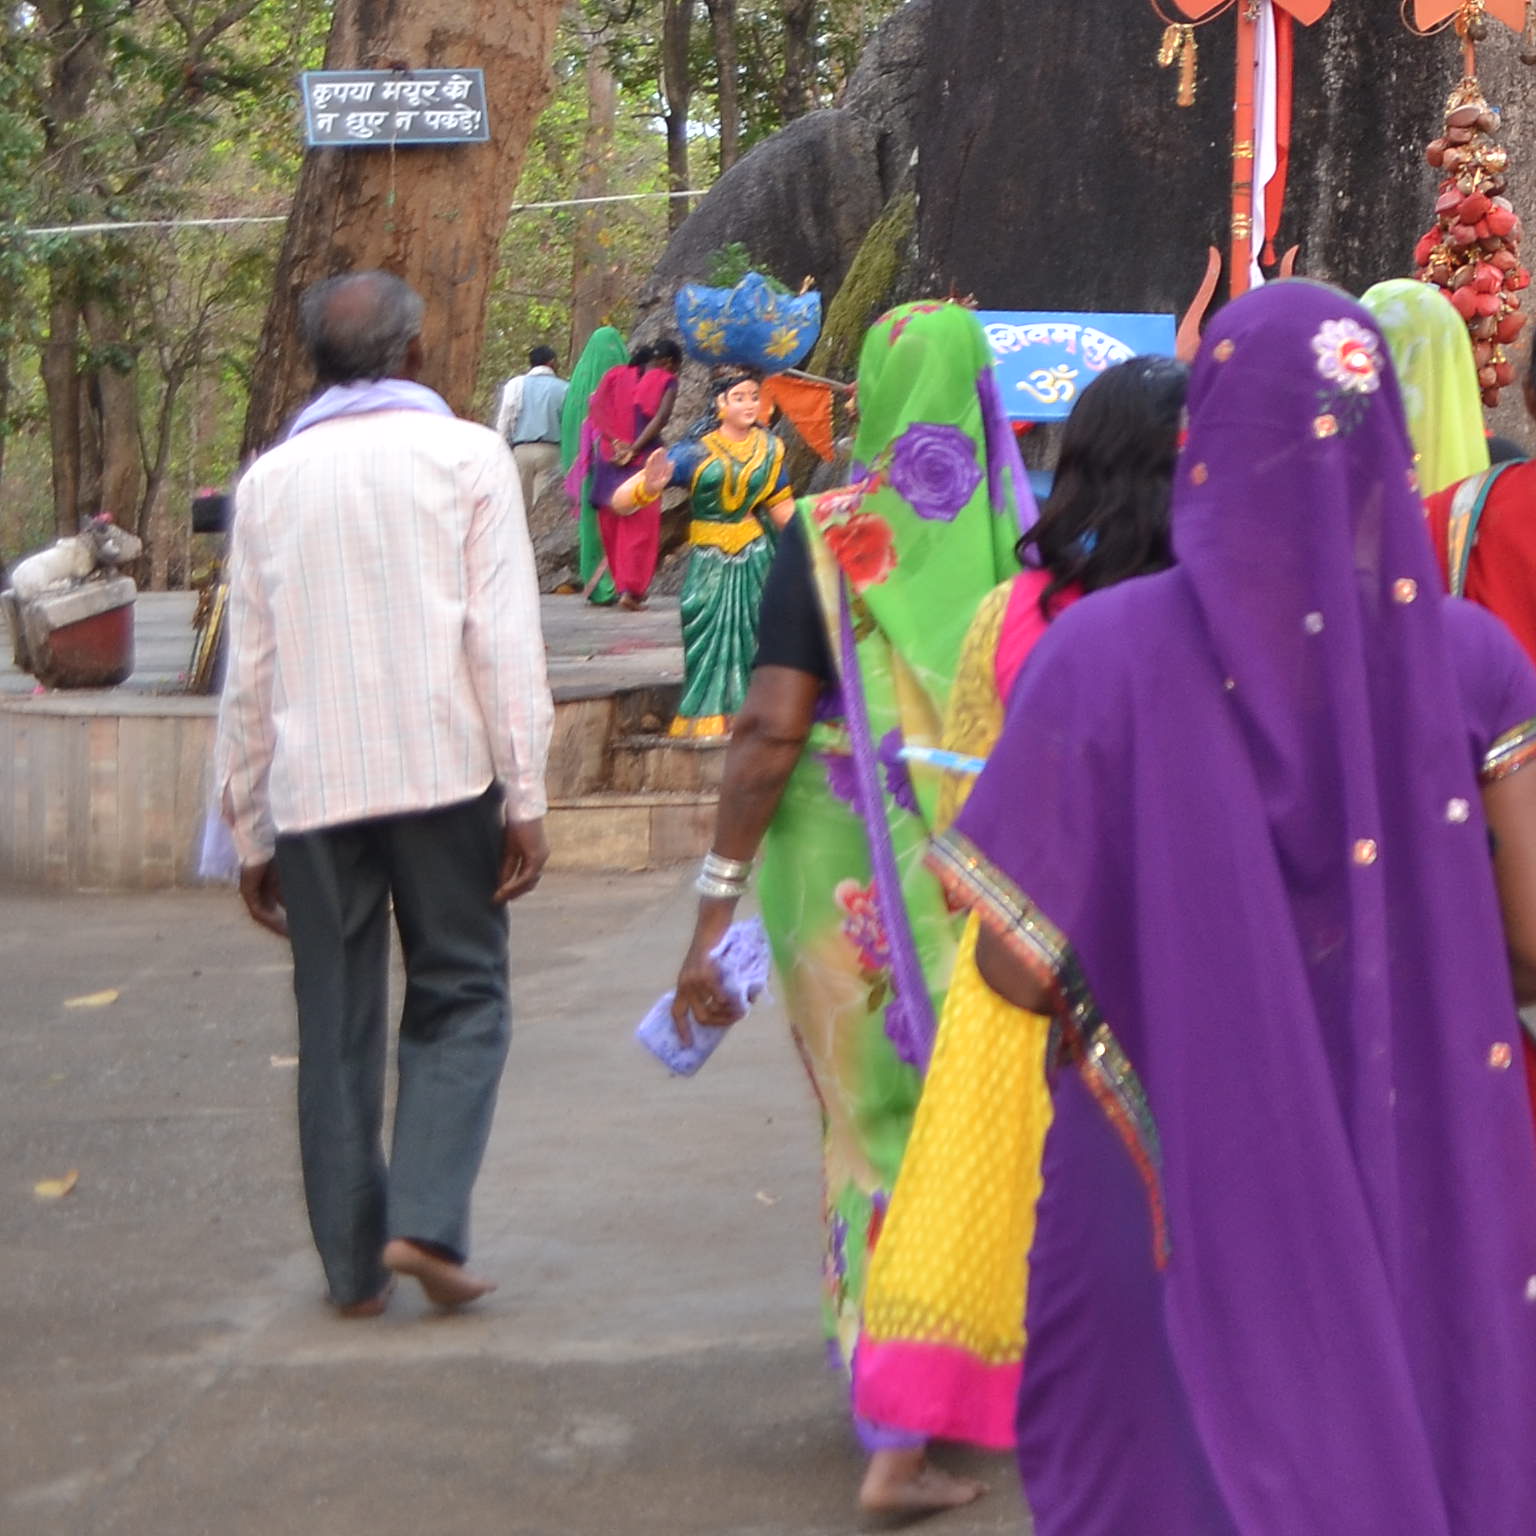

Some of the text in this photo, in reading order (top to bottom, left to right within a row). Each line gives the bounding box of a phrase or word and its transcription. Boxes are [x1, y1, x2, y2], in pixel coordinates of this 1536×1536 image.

[312, 81, 375, 110] कृपया
[441, 73, 473, 101] को
[315, 112, 340, 134] न
[394, 110, 420, 132] न
